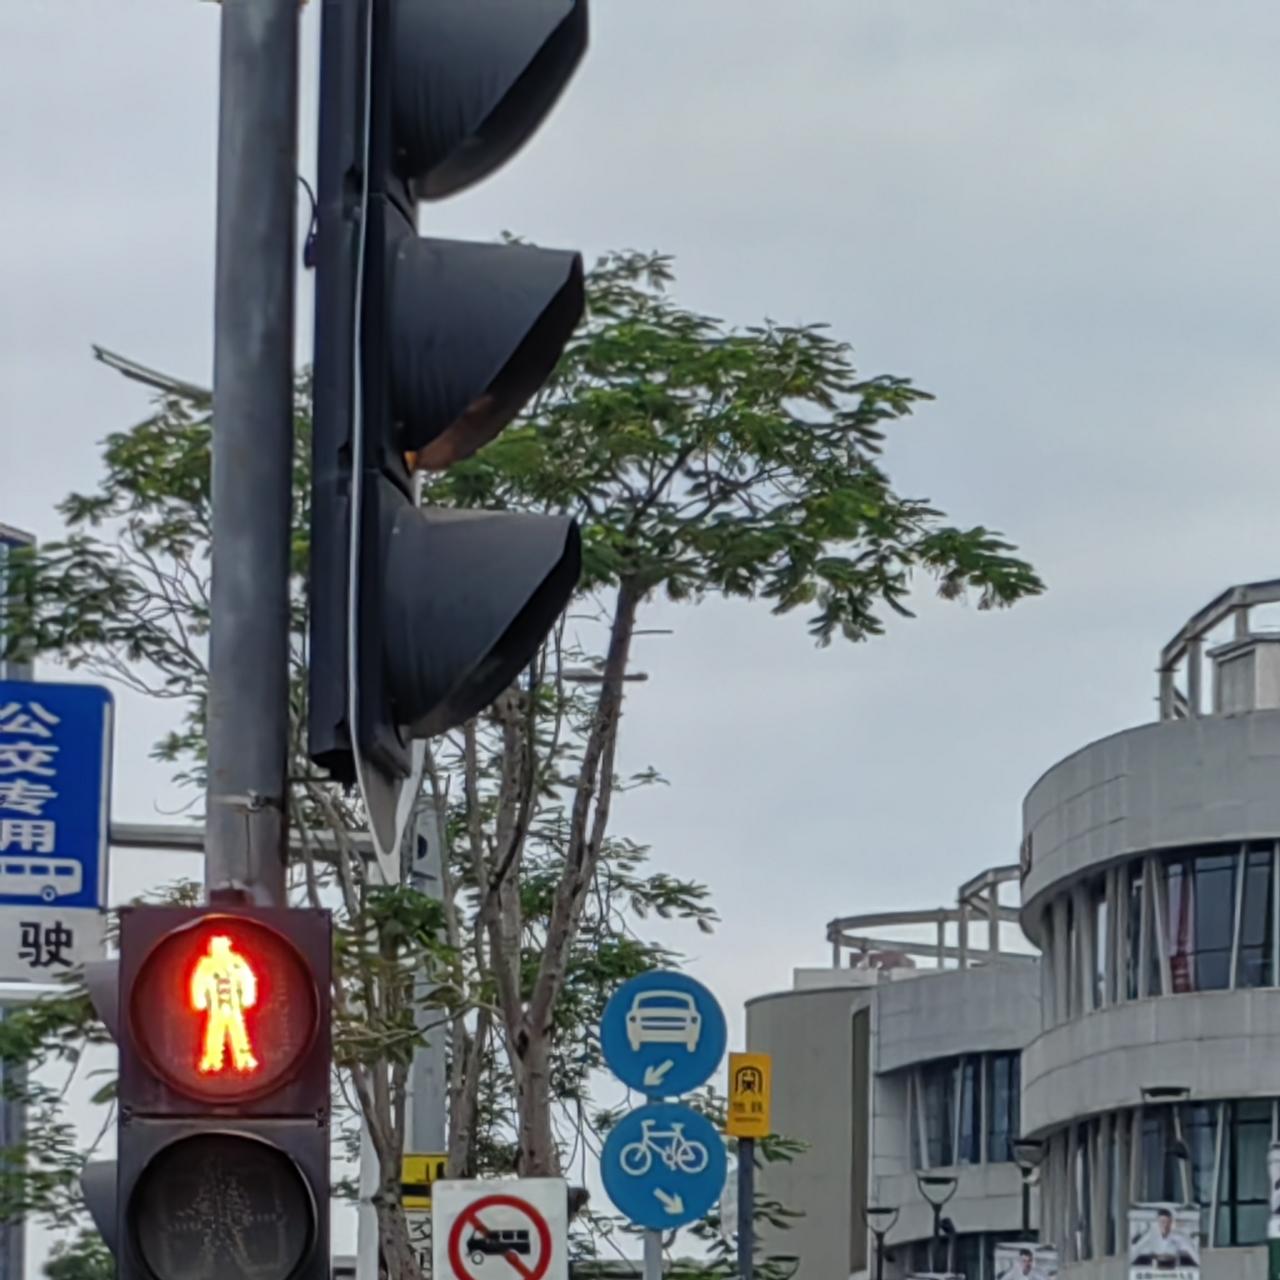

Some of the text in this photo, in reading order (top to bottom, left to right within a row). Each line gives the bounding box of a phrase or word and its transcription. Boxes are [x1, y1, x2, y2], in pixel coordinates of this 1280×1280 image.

[0, 701, 60, 852] 公交专用
[18, 921, 74, 968] 驶
